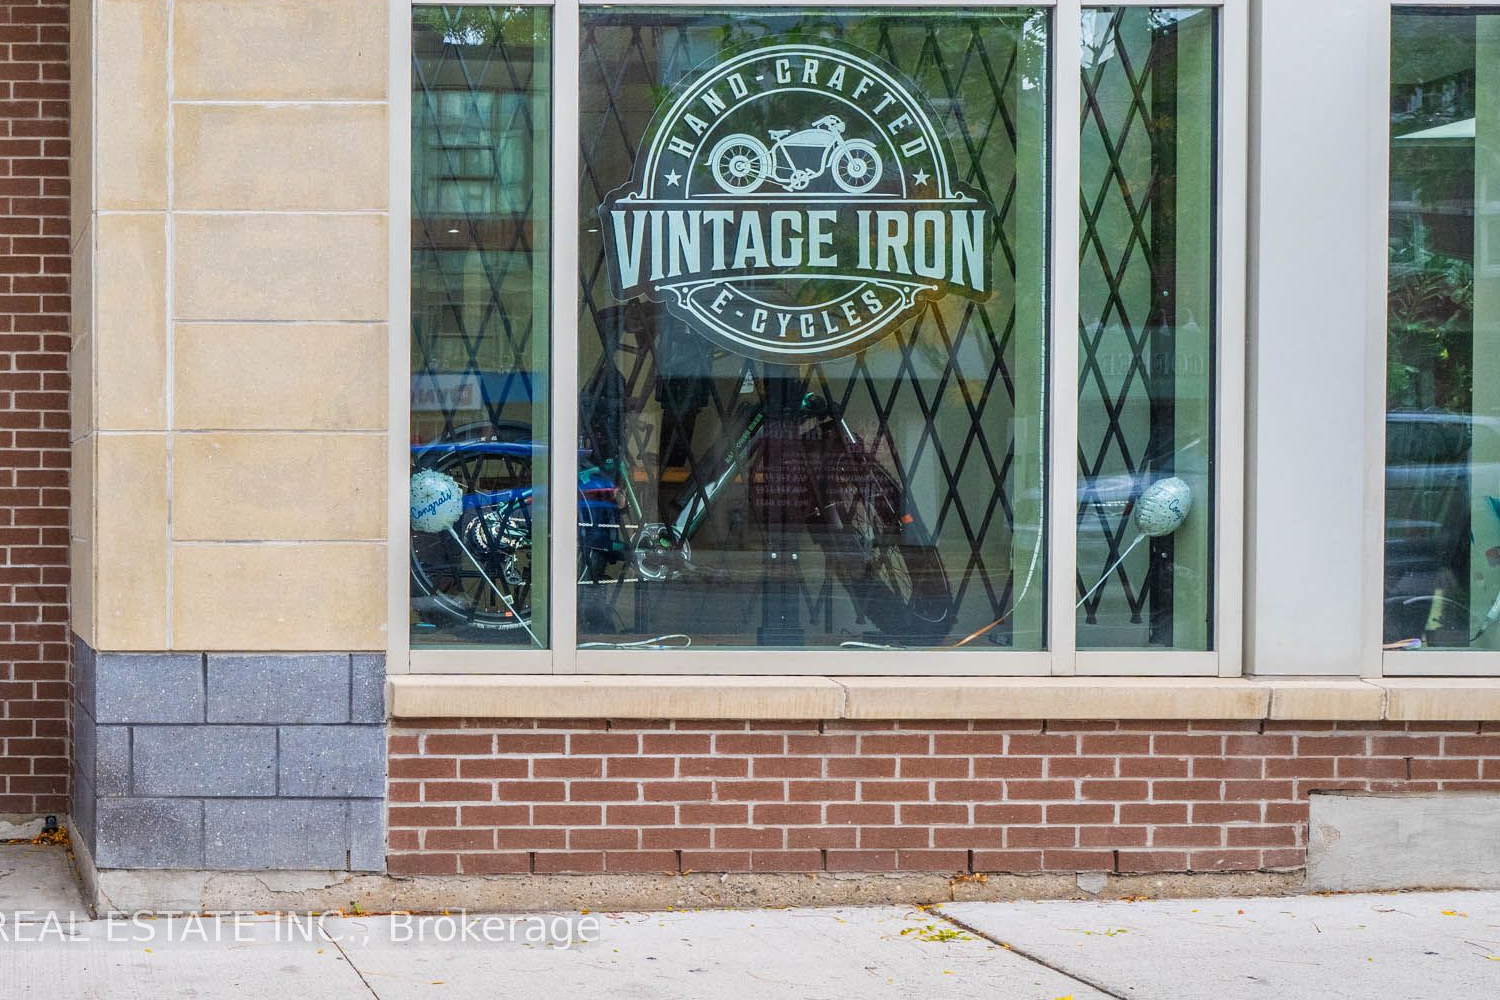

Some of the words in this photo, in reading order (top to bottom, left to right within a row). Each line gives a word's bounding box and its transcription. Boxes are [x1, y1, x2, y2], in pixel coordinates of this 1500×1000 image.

[668, 58, 928, 159] HAND-CRAFTED
[610, 210, 837, 290] VINTAGE
[856, 210, 987, 292] IRON
[710, 288, 884, 339] E-CYCLES
